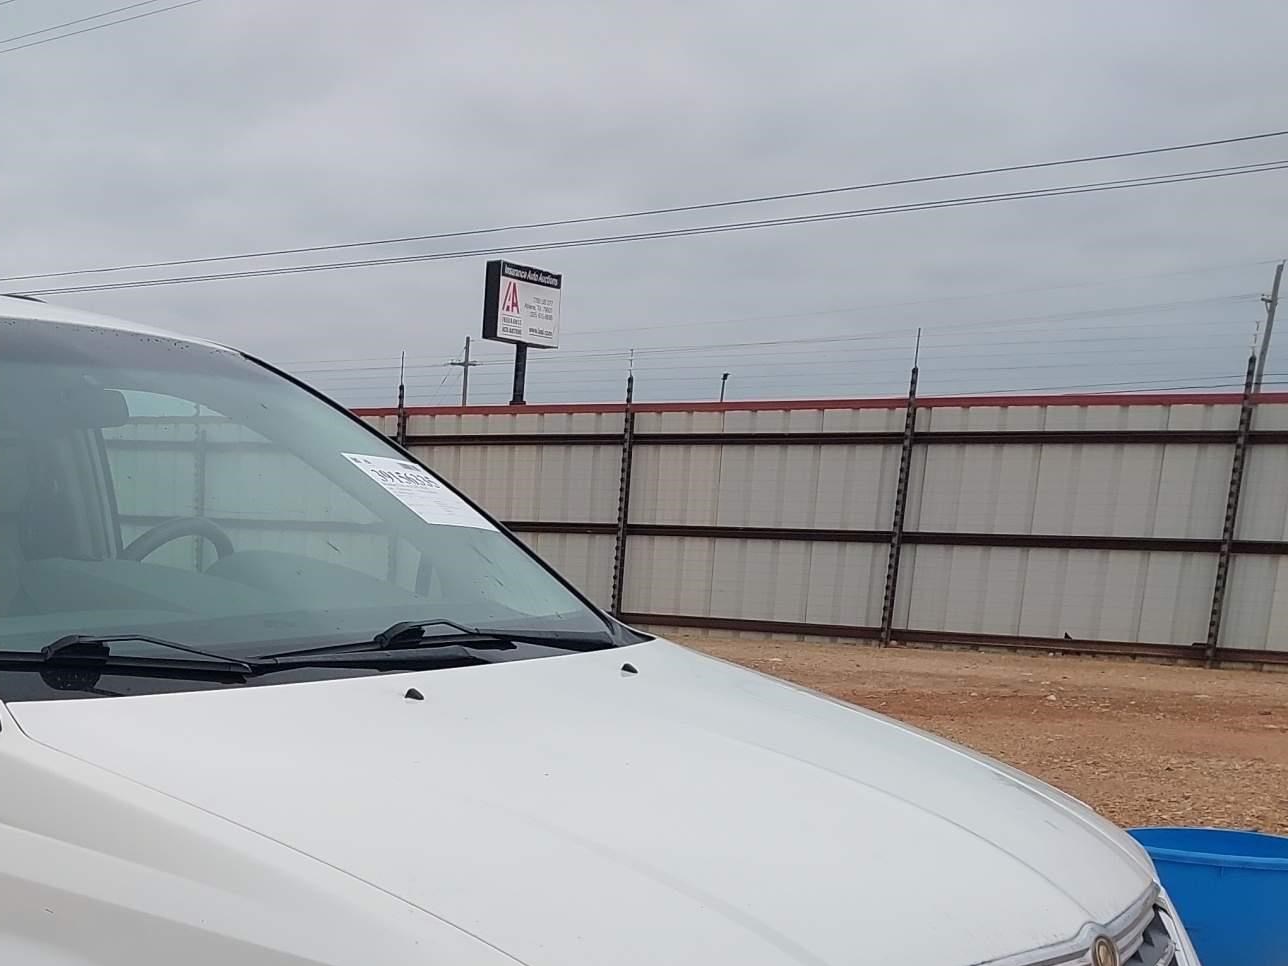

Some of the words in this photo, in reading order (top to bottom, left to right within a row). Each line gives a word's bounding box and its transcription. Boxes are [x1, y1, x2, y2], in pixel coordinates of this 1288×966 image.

[505, 264, 527, 279] Insurance
[527, 270, 538, 282] Auto
[538, 272, 558, 287] Auctions
